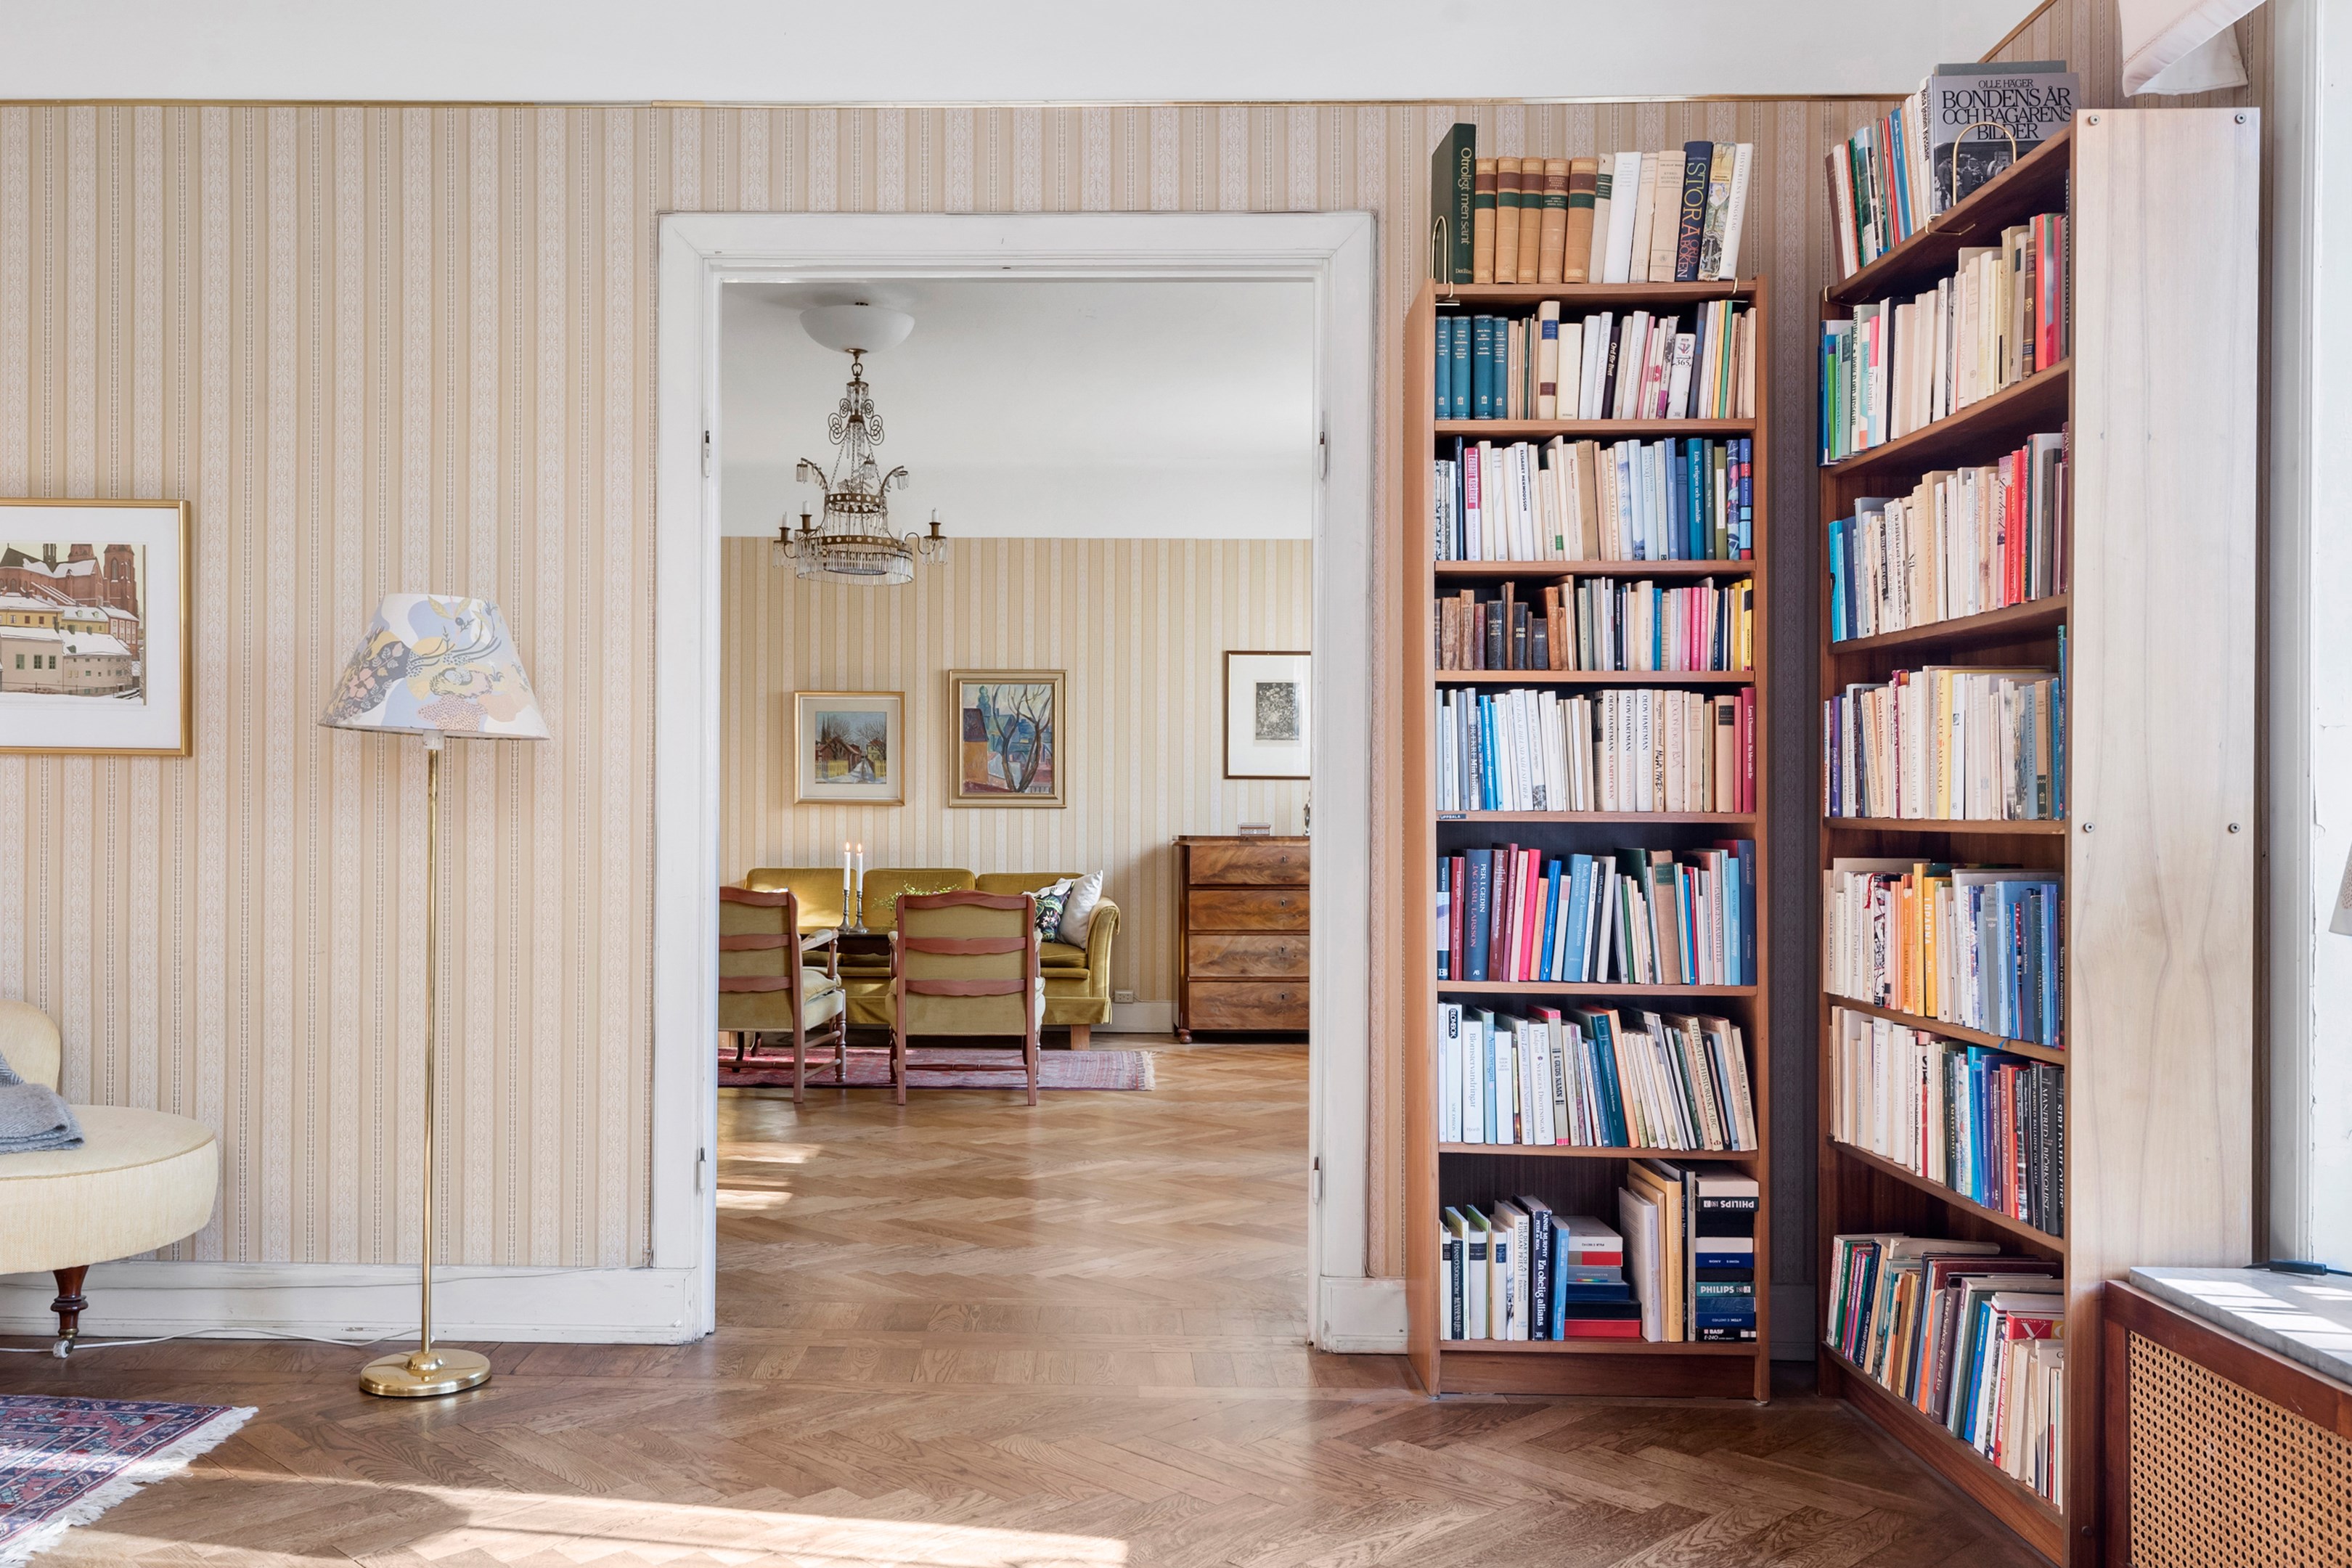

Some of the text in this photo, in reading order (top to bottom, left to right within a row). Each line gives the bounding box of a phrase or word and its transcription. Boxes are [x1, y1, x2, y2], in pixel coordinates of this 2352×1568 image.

[1978, 78, 2033, 89] OLLE HÄGER
[1942, 86, 2072, 109] BONDENS ÅR
[1920, 105, 1929, 129] genom
[1943, 106, 2071, 125] OCH BAGARENS
[1977, 123, 2039, 140] BILDER
[1458, 147, 1472, 191] Otroligt
[1680, 163, 1707, 240] STORA
[1461, 221, 1471, 245] sant
[1677, 240, 1691, 278] BOKEN
[1468, 454, 1479, 504] Lennart Koskinen
[1576, 905, 1585, 946] kontemplation
[1923, 897, 1933, 944] LÖPARNA
[1468, 1033, 1477, 1108] Blomstervandringar
[2042, 1146, 2051, 1212] BJÖRKQUIST
[1522, 1256, 1528, 1265] OF
[1538, 1259, 1546, 1271] En
[1535, 1271, 1547, 1298] ohelig
[1858, 1340, 1866, 1364] HESSLER
